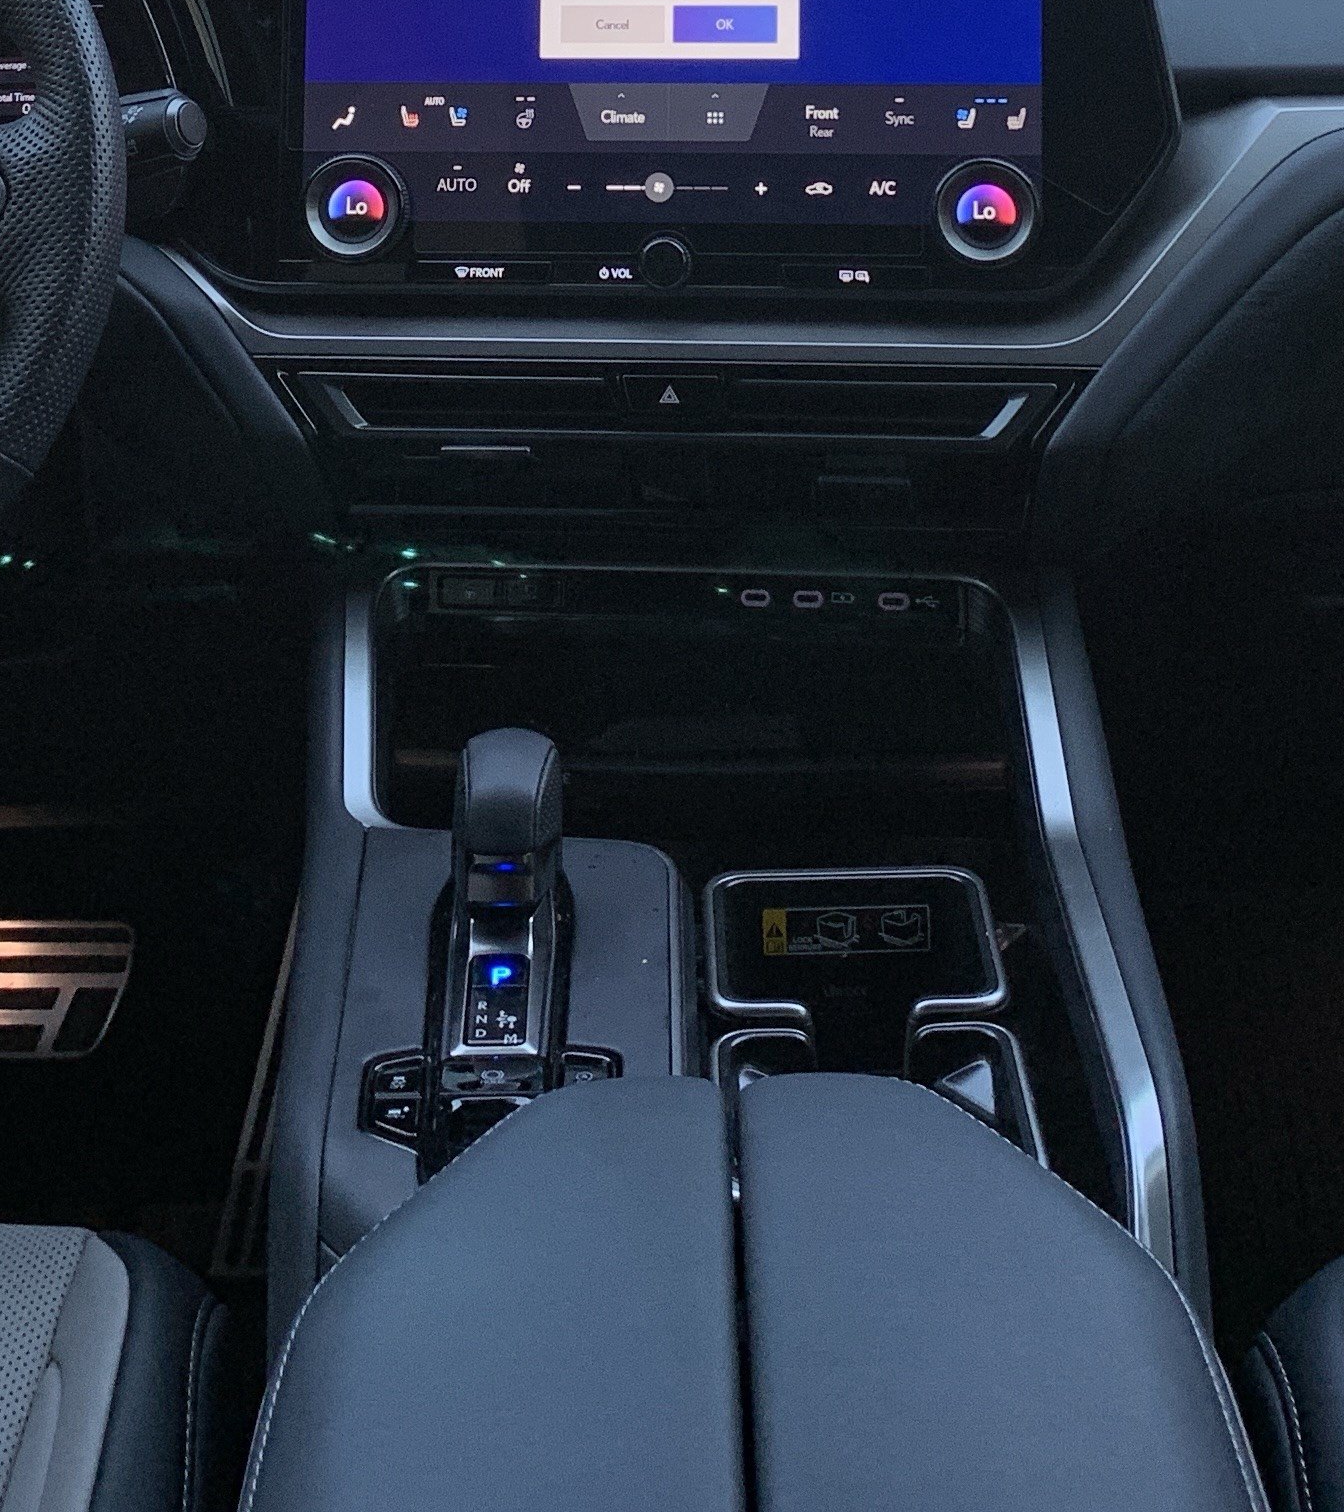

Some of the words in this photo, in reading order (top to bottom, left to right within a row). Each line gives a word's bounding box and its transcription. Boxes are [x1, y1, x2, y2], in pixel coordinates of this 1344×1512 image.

[595, 19, 630, 30] Cancel
[715, 19, 734, 31] OK
[14, 92, 35, 101] Time
[424, 97, 445, 106] AUTO
[600, 109, 646, 124] Climate
[805, 105, 839, 120] Front
[885, 111, 915, 127] Sync
[809, 125, 834, 138] Rear
[436, 178, 477, 192] AUTO
[507, 179, 532, 194] Off
[869, 181, 897, 196] A/C
[345, 196, 368, 215] Lo
[972, 200, 997, 220] Lo
[469, 267, 505, 278] FRONT
[611, 268, 633, 279] VOL
[492, 966, 512, 986] P
[477, 1000, 488, 1010] R
[476, 1014, 488, 1024] N
[476, 1028, 487, 1038] D
[503, 1033, 518, 1044] M
